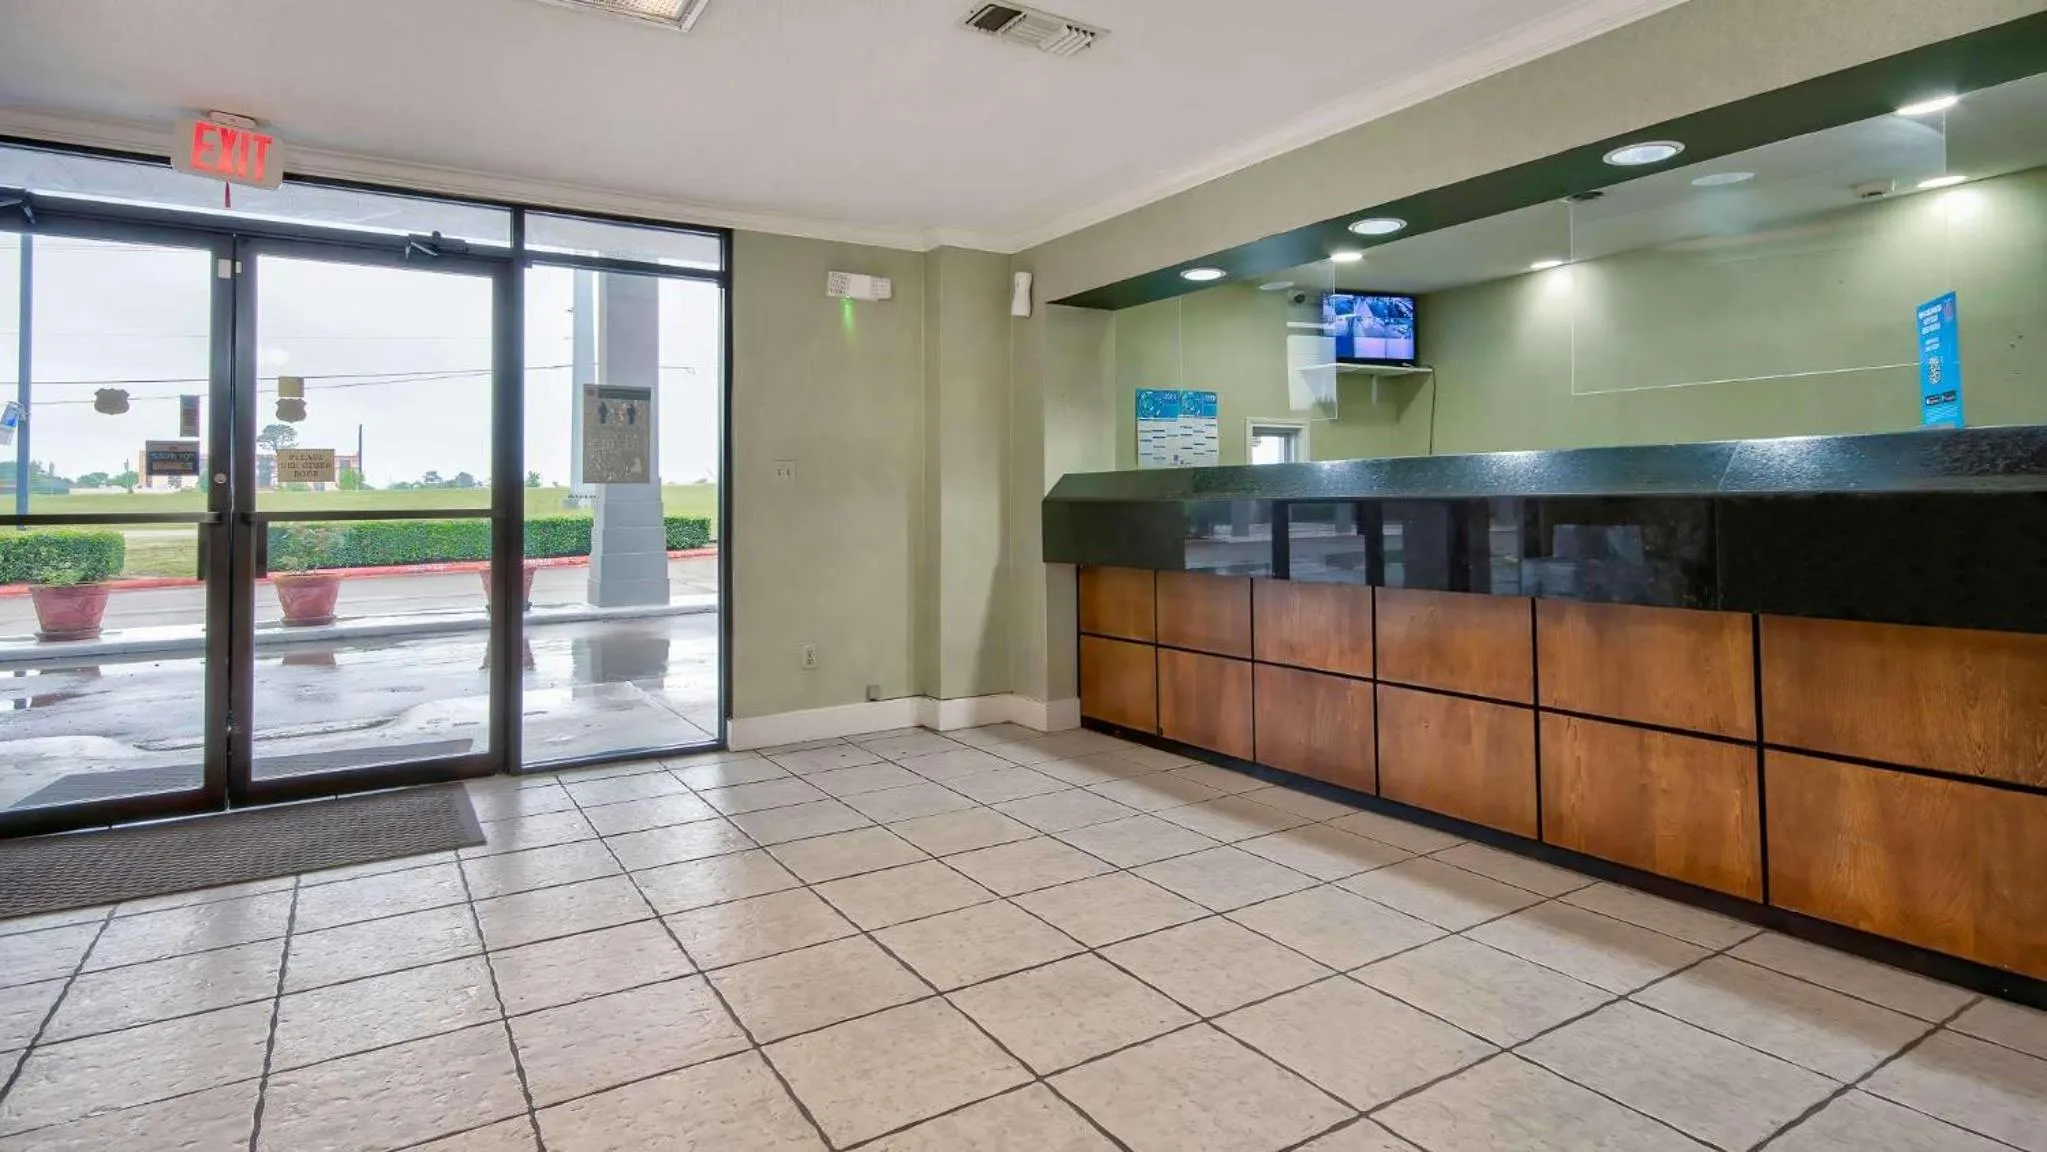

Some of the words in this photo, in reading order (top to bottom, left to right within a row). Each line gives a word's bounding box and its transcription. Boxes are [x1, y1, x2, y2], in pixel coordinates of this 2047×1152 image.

[191, 121, 273, 181] EXIT
[288, 453, 325, 461] PLEASE
[294, 470, 319, 478] DOOR
